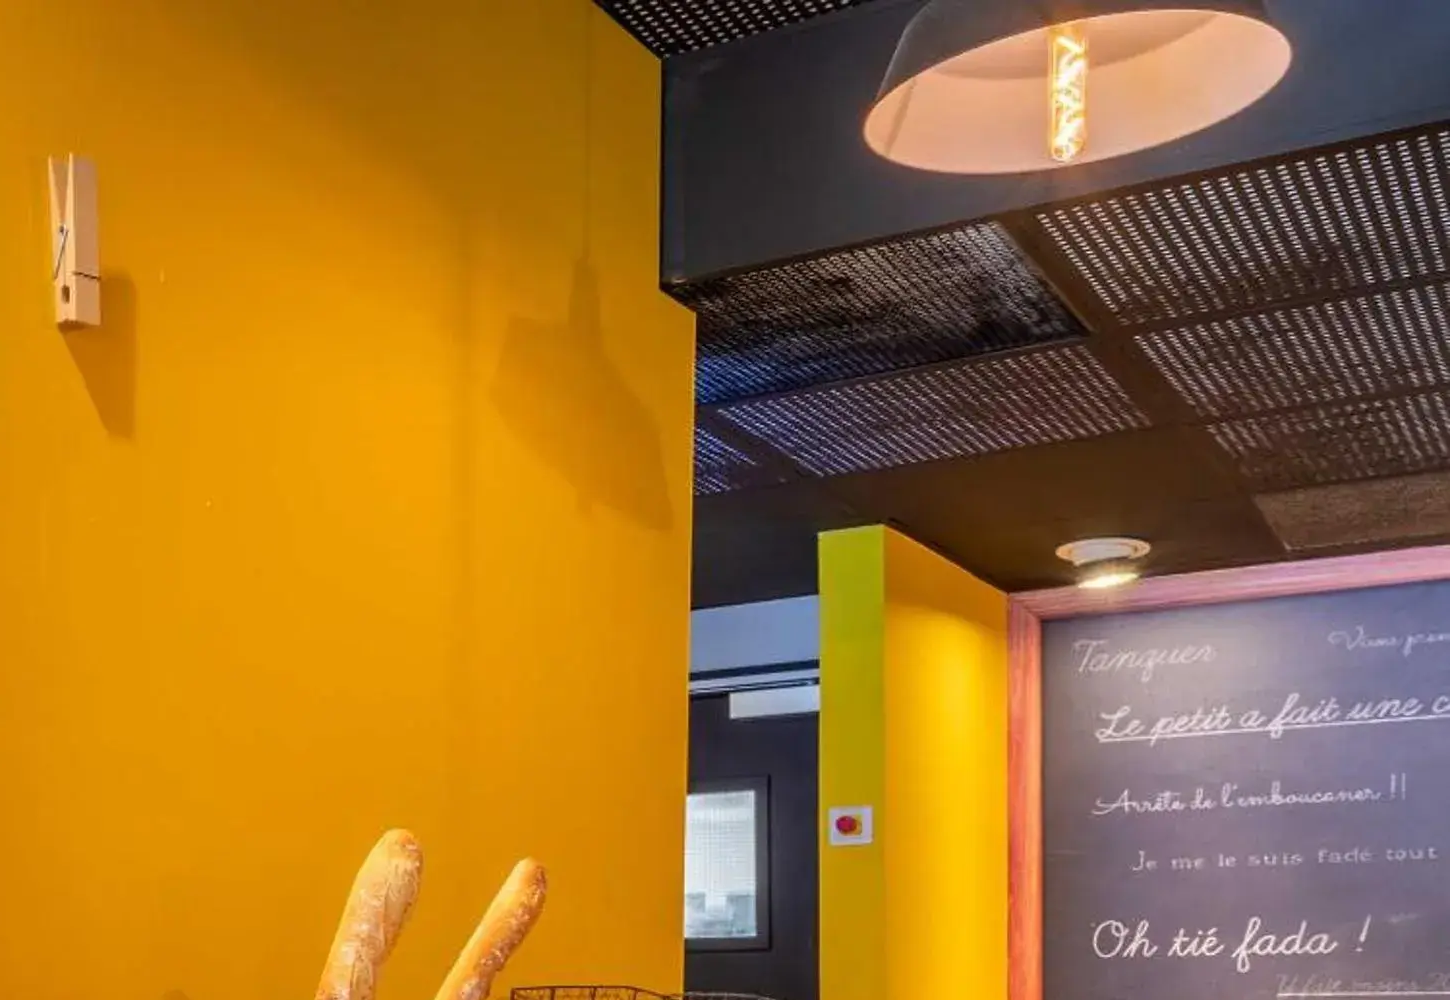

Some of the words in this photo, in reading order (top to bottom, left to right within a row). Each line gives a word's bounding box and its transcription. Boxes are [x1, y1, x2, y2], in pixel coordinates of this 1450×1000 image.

[1095, 705, 1146, 739] Le
[1150, 704, 1232, 747] petit
[1239, 713, 1267, 730] a
[1266, 693, 1341, 739] fait
[1346, 697, 1425, 720] une
[1131, 850, 1158, 871] Je
[1171, 856, 1206, 871] me
[1218, 852, 1238, 868] le
[1247, 851, 1302, 867] suis
[1093, 919, 1159, 958] Oh
[1167, 927, 1225, 957] tié
[1231, 916, 1338, 973] fada
[1355, 914, 1372, 952] !
